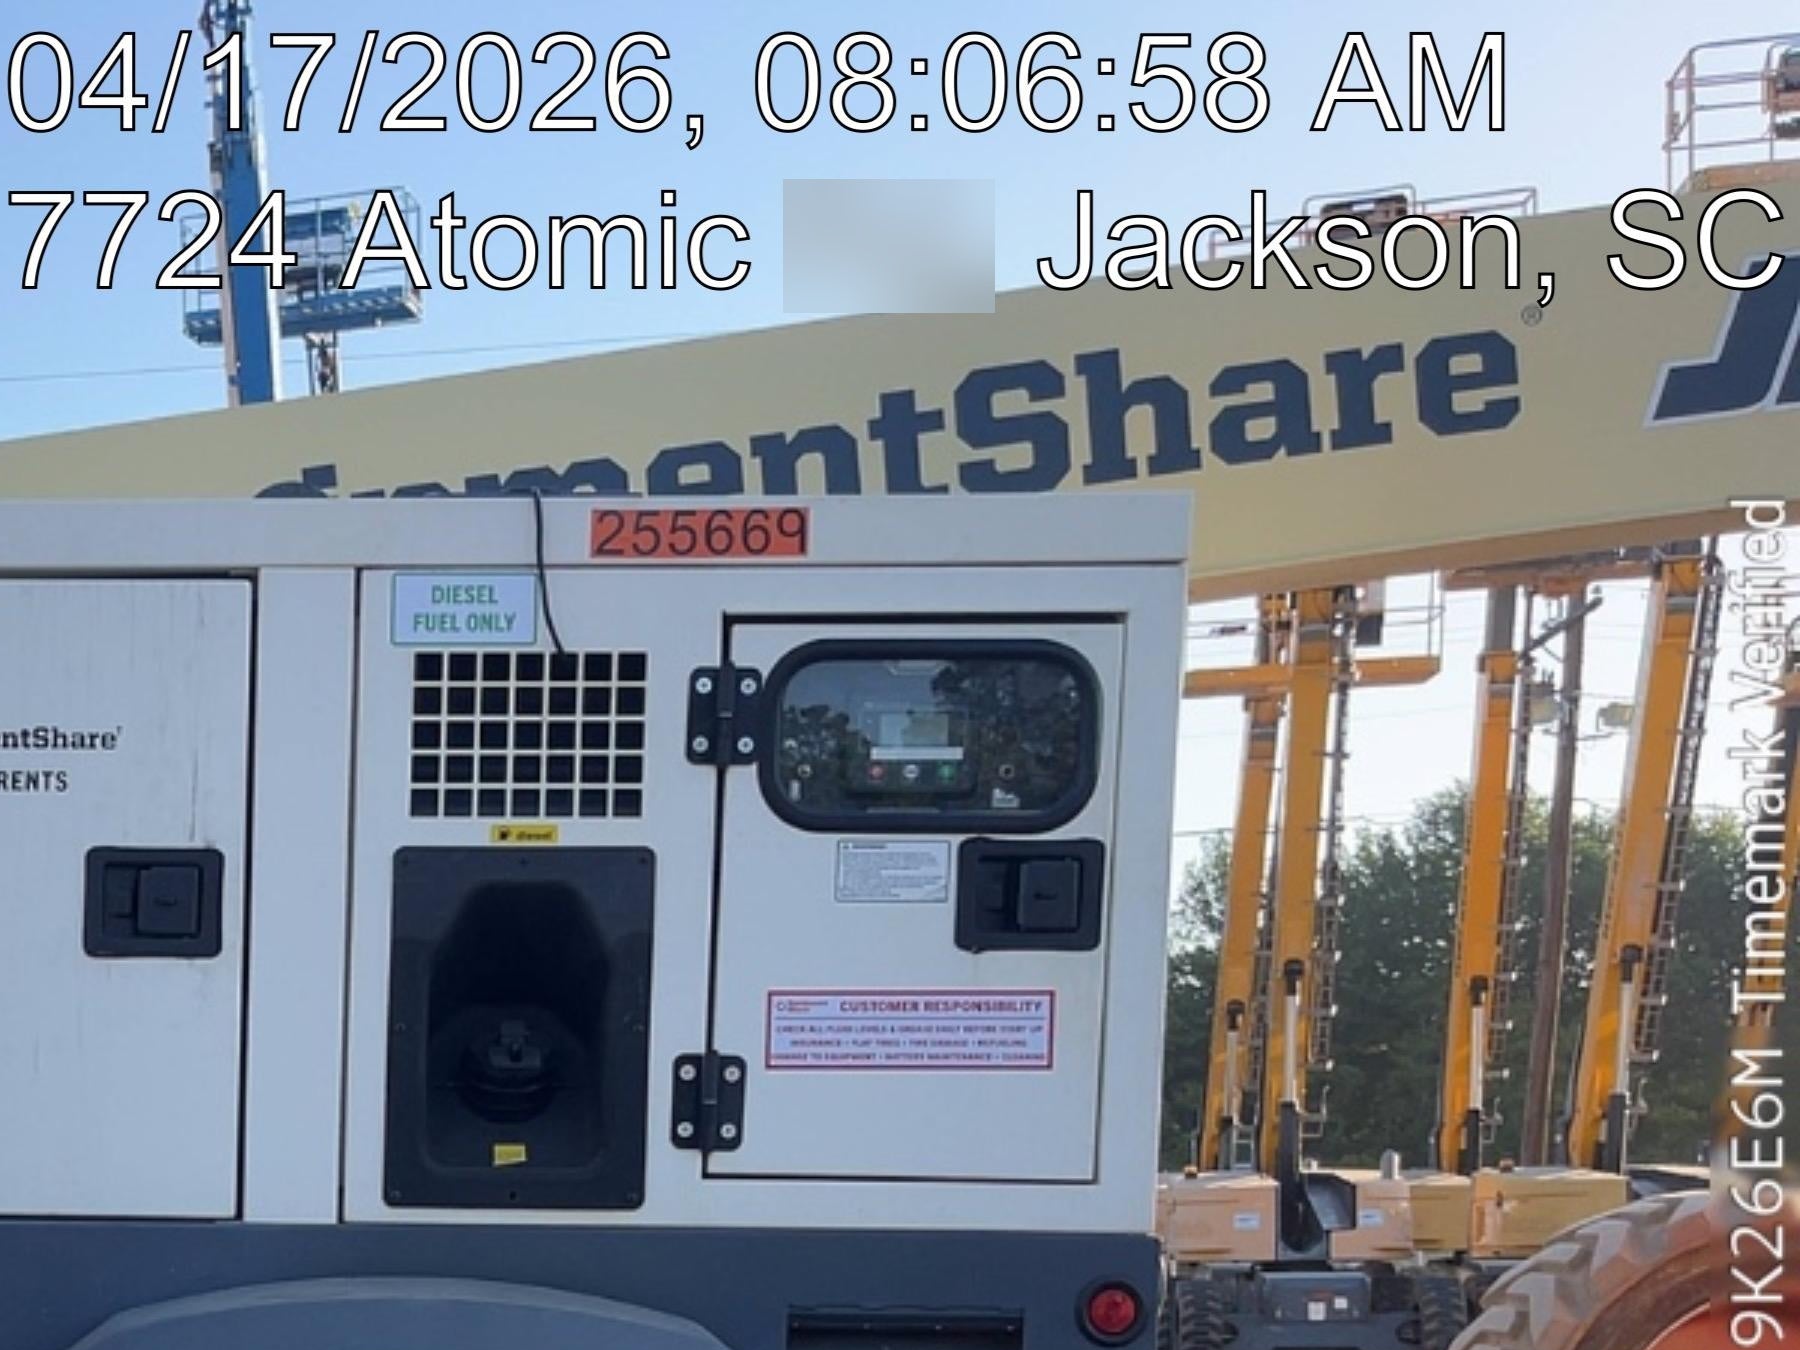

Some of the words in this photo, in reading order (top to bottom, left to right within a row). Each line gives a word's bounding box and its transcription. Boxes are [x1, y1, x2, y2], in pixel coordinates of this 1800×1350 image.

[1646, 254, 1800, 425] J
[595, 508, 808, 555] 255669
[431, 584, 498, 605] DIESEL
[413, 612, 462, 633] FUEL
[465, 612, 516, 633] ONLY
[839, 1000, 919, 1012] CUSTOMER
[923, 1000, 1042, 1012] RESPONSIBILITY
